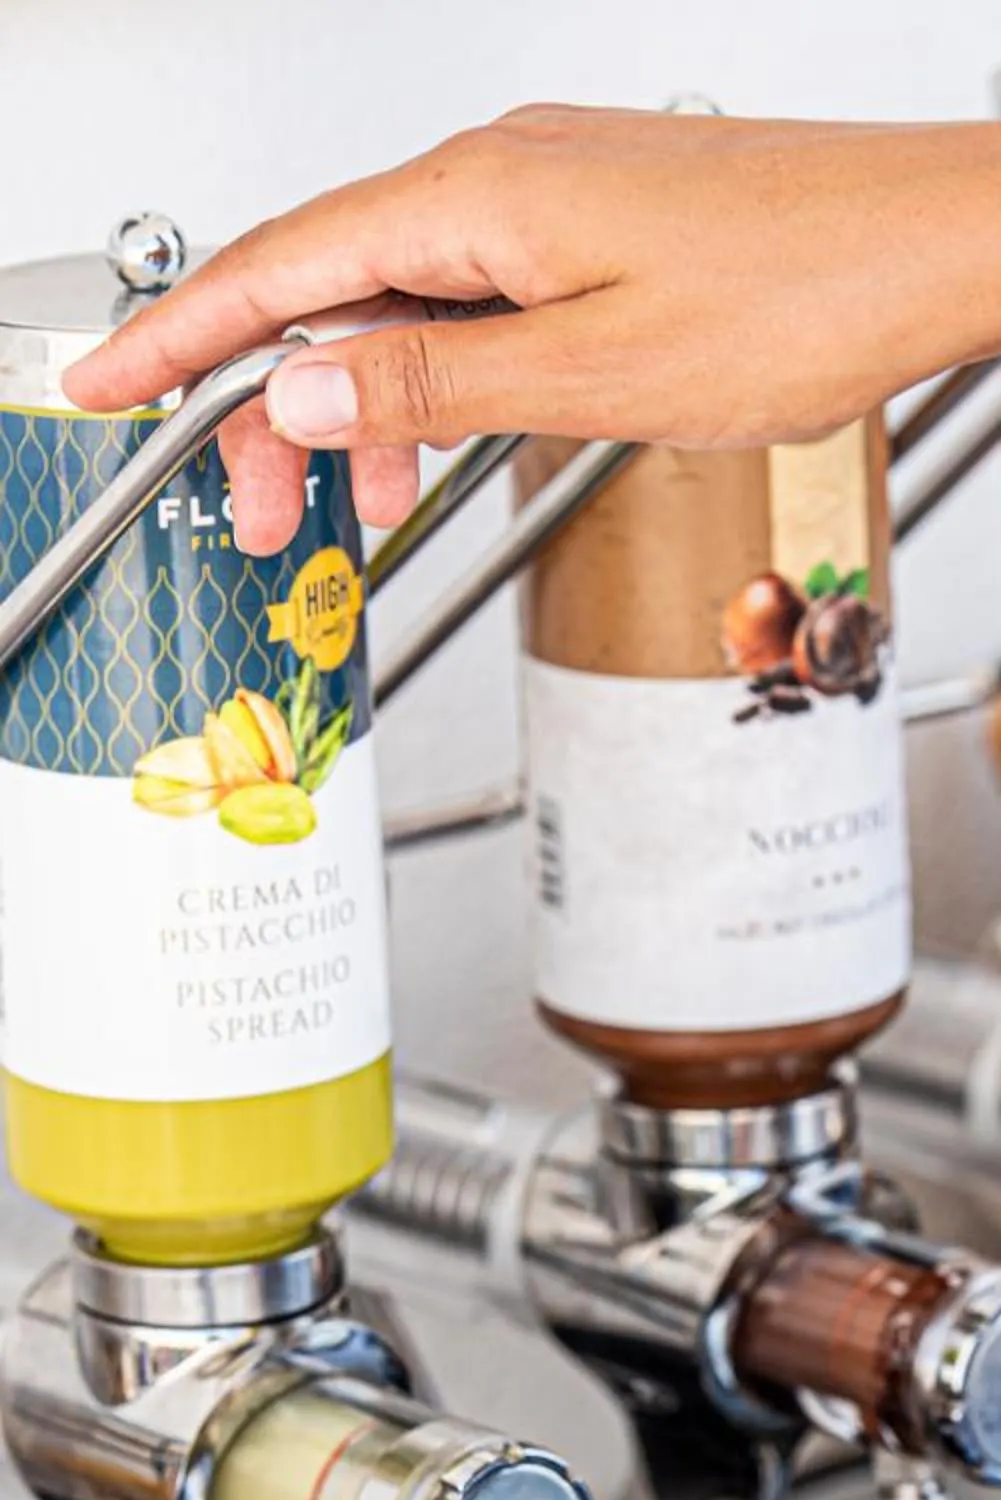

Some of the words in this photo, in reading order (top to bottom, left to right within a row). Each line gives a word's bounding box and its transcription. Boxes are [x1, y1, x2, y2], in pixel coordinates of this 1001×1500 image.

[176, 876, 303, 915] CREMA
[313, 863, 341, 896] DI
[160, 897, 356, 954] PISTACCHIO
[176, 955, 351, 1008] PISTACHIO
[207, 1000, 334, 1044] SPREAD
